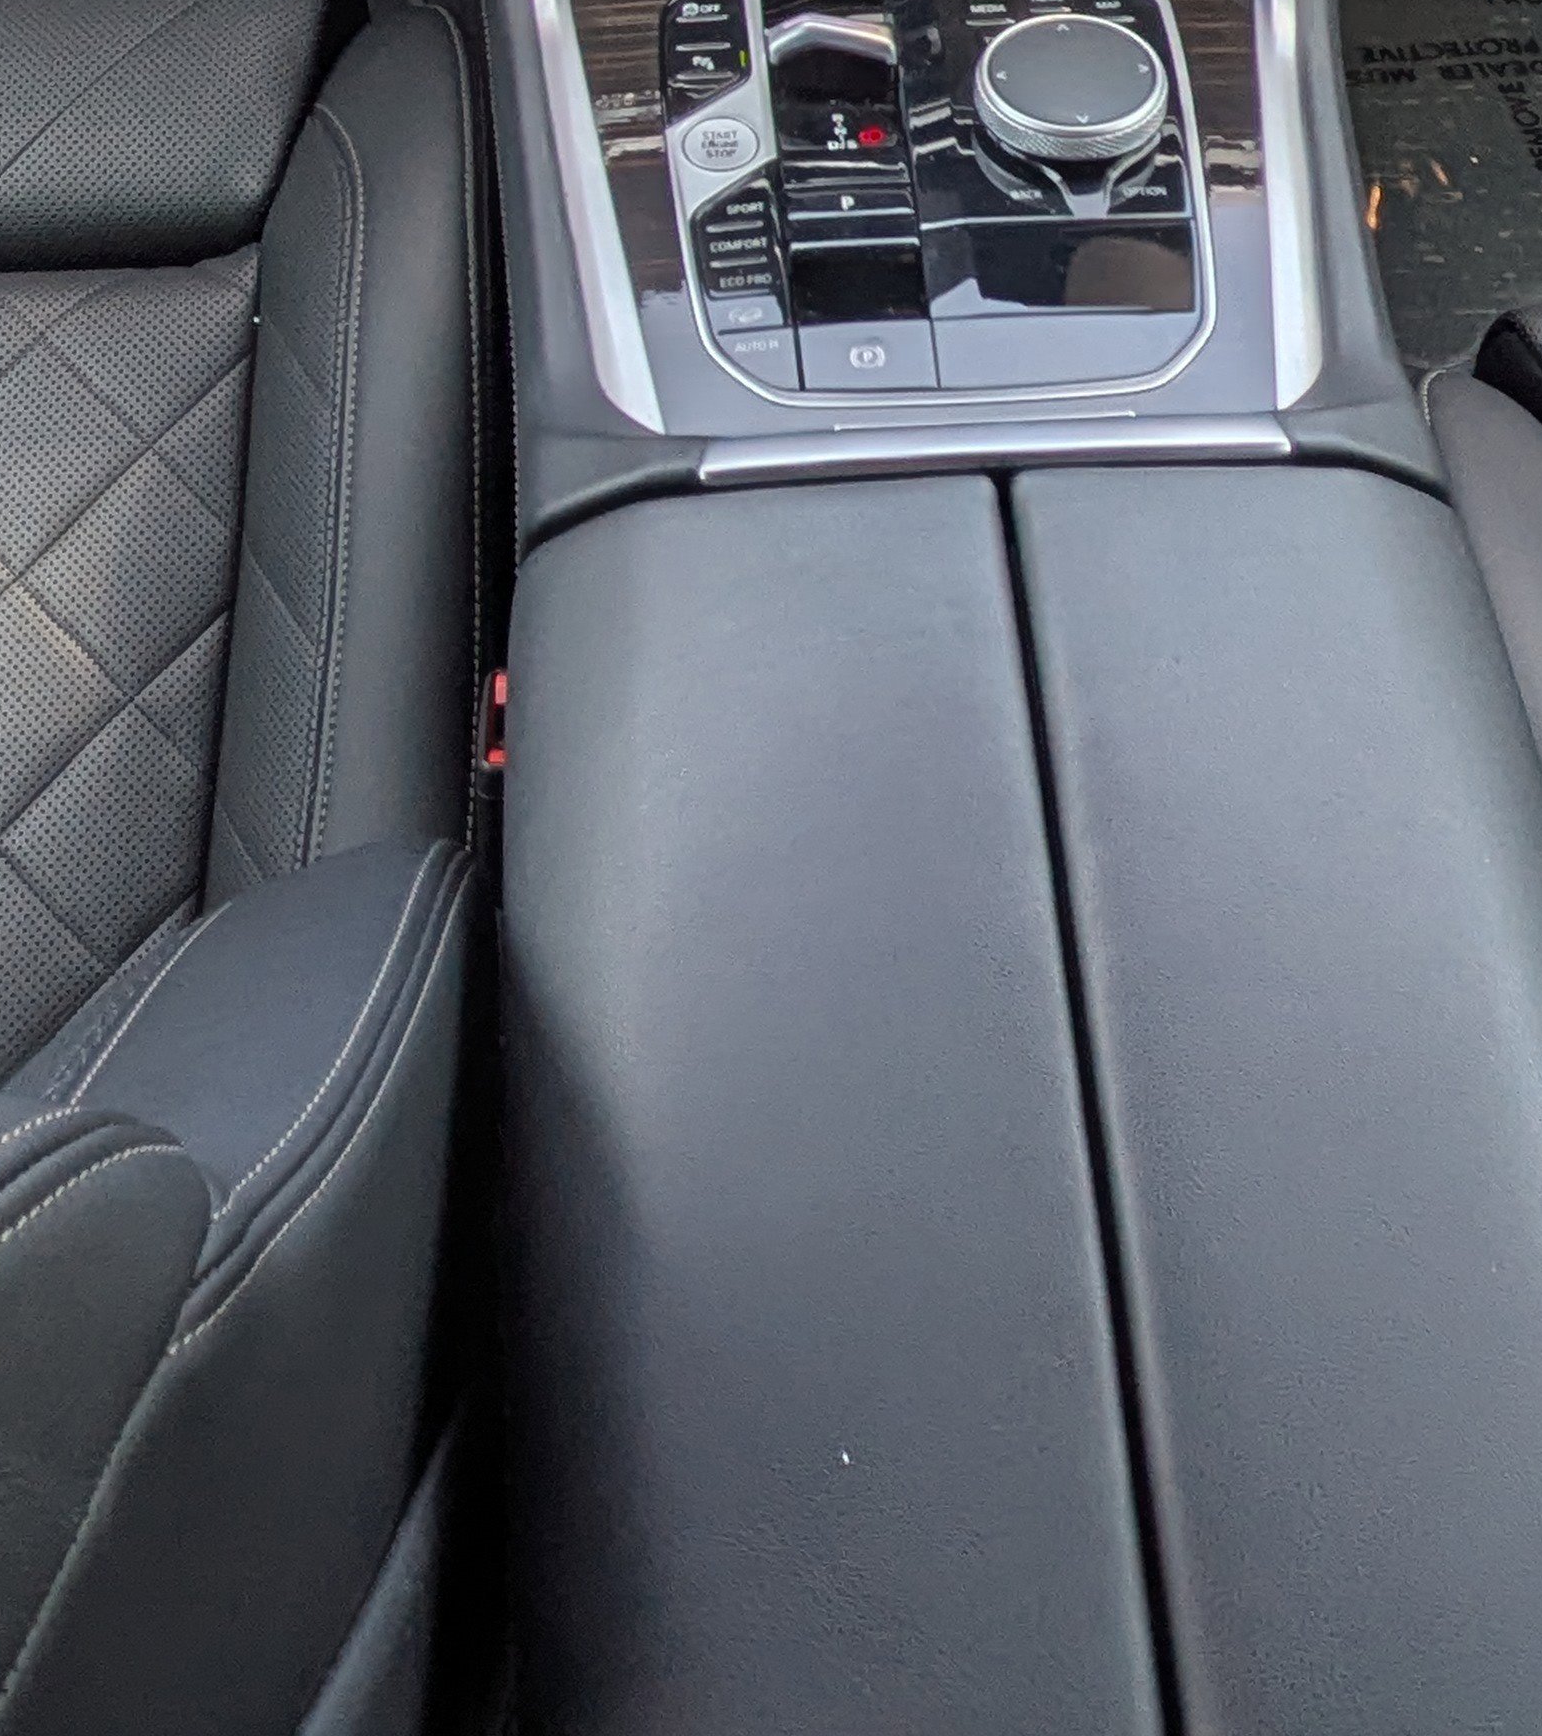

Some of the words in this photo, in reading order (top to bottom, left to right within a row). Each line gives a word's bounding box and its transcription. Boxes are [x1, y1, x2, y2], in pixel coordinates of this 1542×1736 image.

[1360, 36, 1542, 63] PROTECTIVE
[725, 201, 765, 215] SPORT
[709, 236, 768, 253] COMFORT
[719, 275, 746, 289] ECO
[734, 340, 767, 354] AUTO
